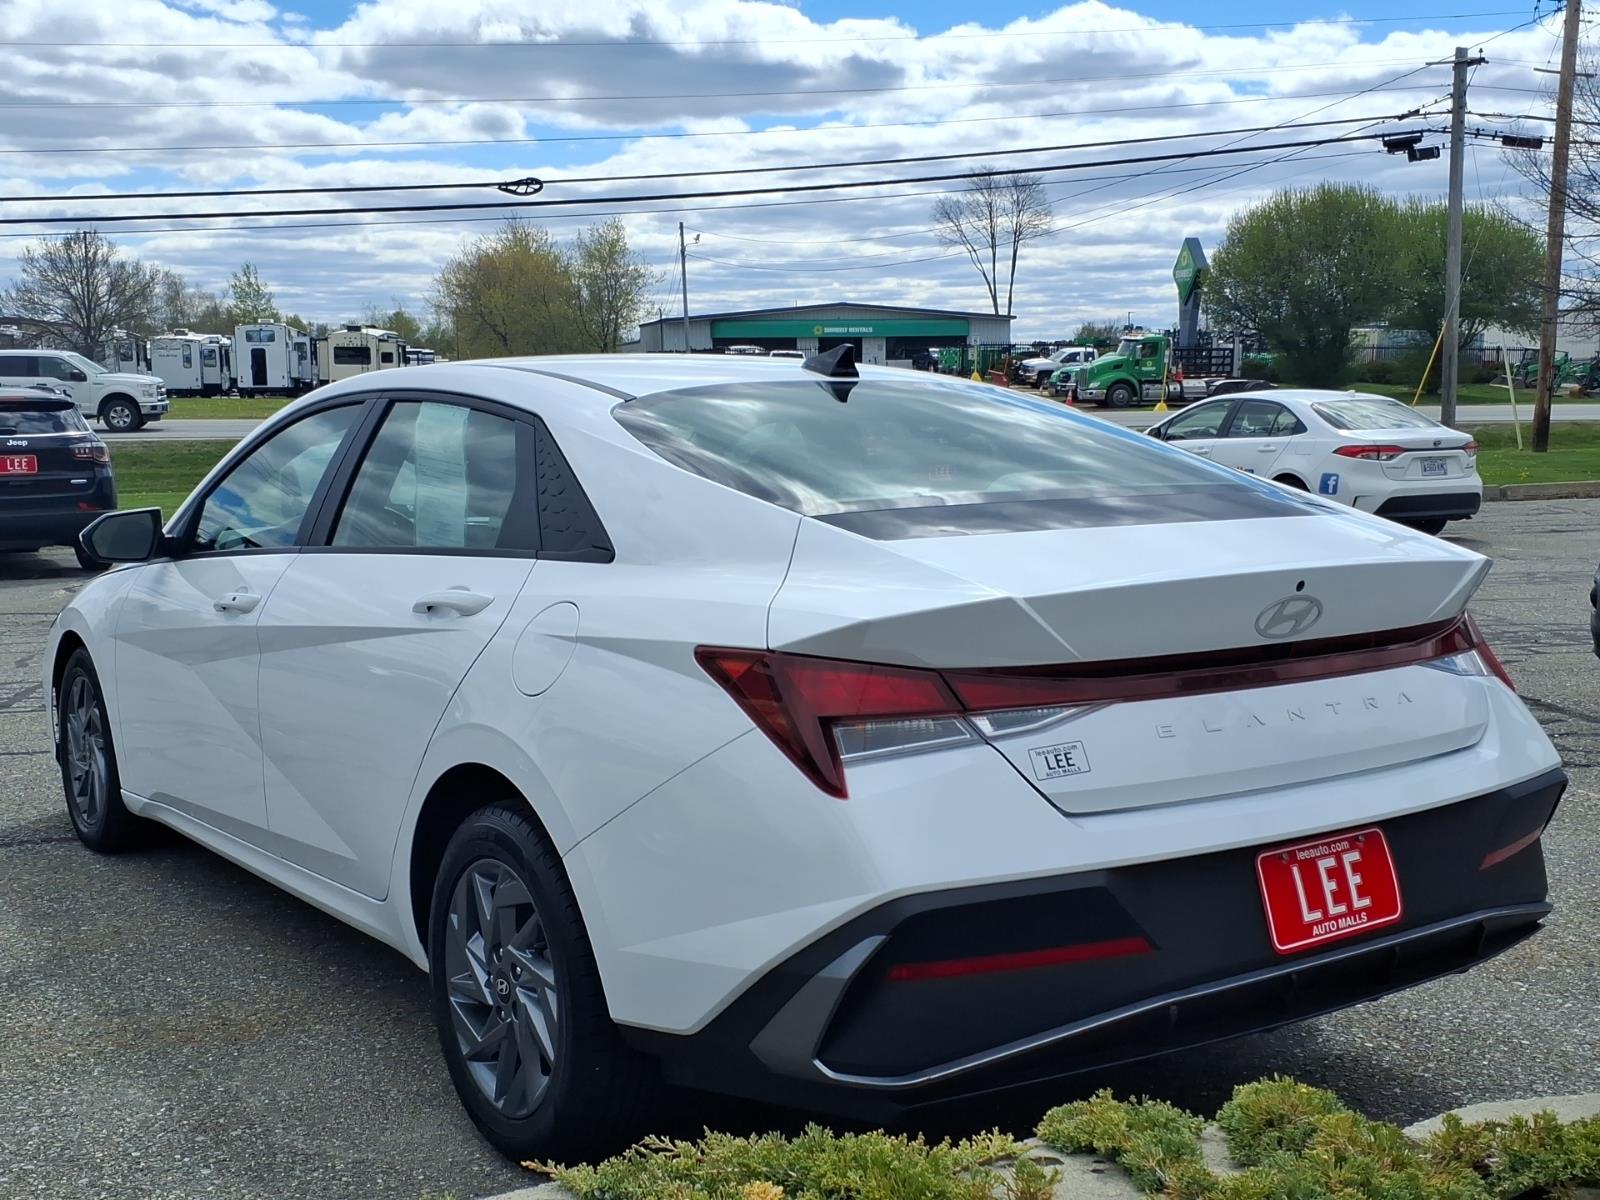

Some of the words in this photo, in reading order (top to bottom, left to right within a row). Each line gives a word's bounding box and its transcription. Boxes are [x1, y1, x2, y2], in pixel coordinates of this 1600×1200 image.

[6, 439, 28, 447] Jeep
[7, 458, 28, 470] LEE
[1155, 692, 1413, 738] ELANTRA
[1034, 744, 1078, 757] leeauto.com
[1044, 751, 1076, 770] LEE
[1061, 766, 1082, 774] MALLS
[1295, 840, 1350, 861] leeauto.com
[1290, 850, 1372, 923] LEE
[1312, 922, 1338, 936] AUTO
[1338, 912, 1368, 929] MALLS
